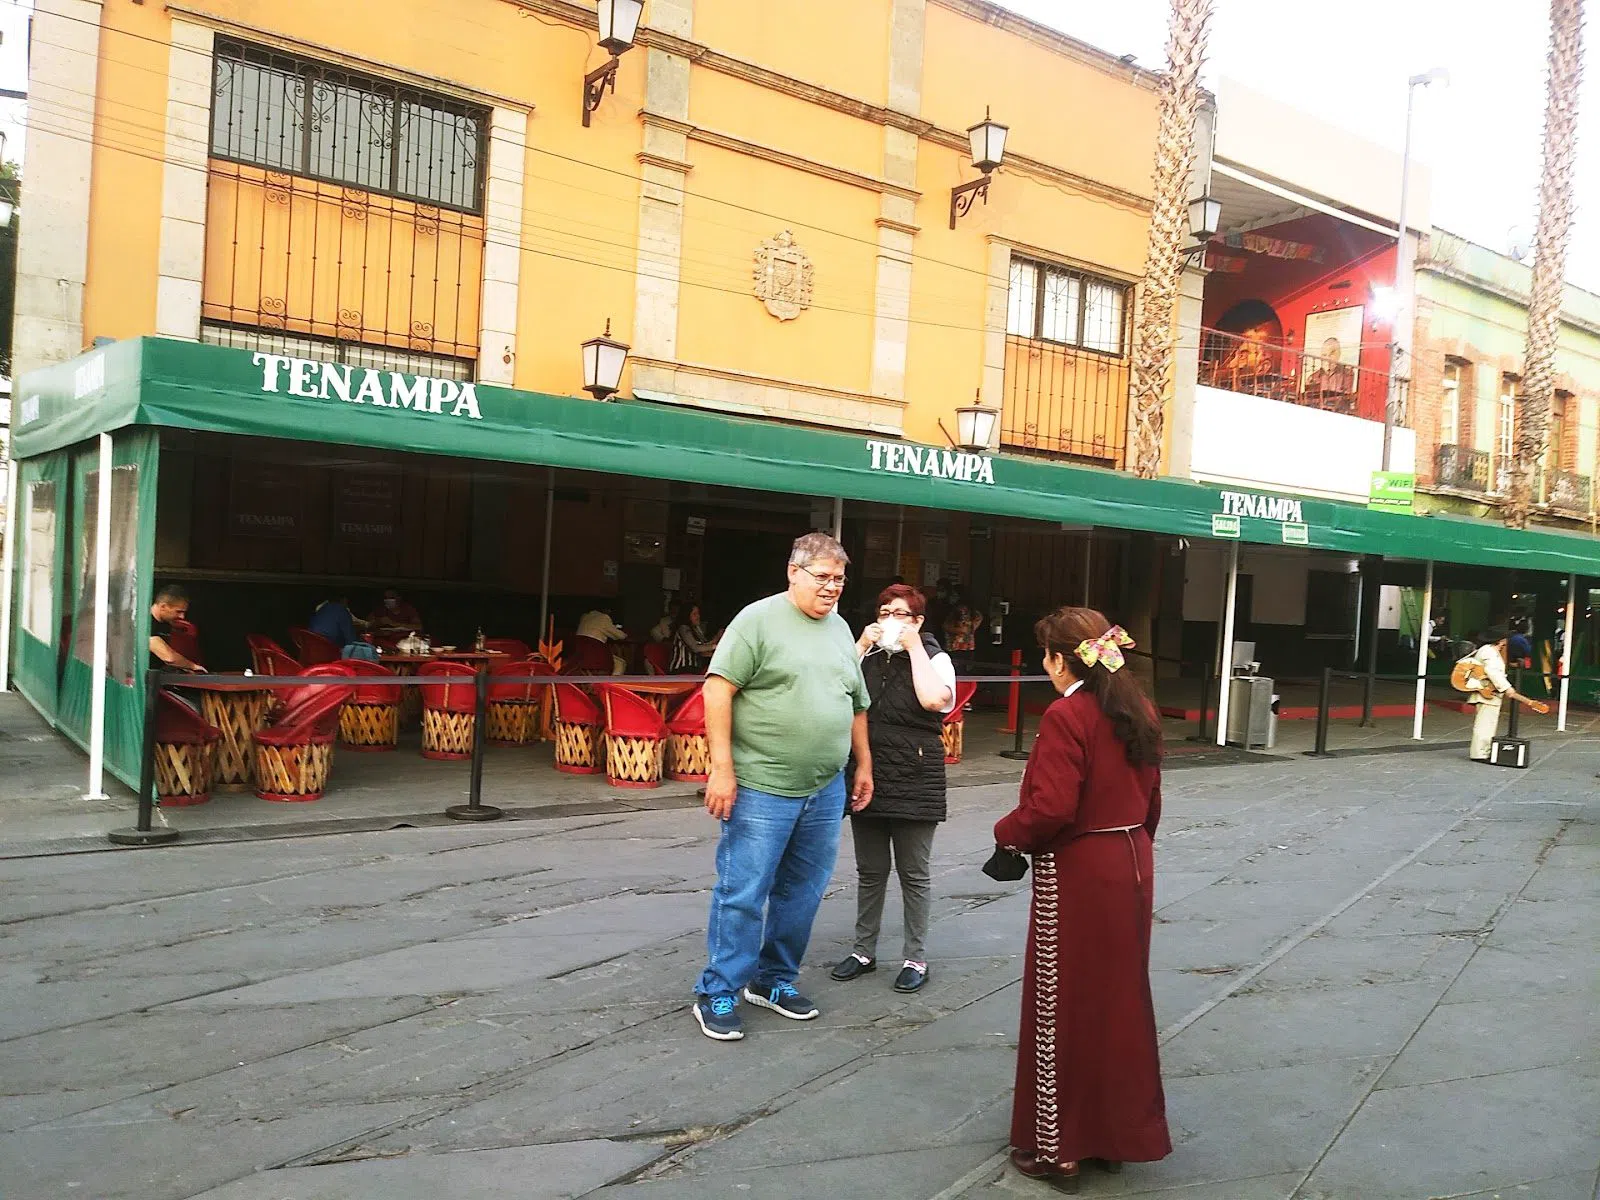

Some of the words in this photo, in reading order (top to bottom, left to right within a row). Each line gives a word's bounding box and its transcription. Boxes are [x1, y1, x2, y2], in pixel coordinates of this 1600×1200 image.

[252, 351, 482, 419] TENAMPA
[866, 440, 995, 485] TENAMPA
[236, 513, 296, 528] TENAMPA
[1220, 490, 1303, 523] TENAMPA
